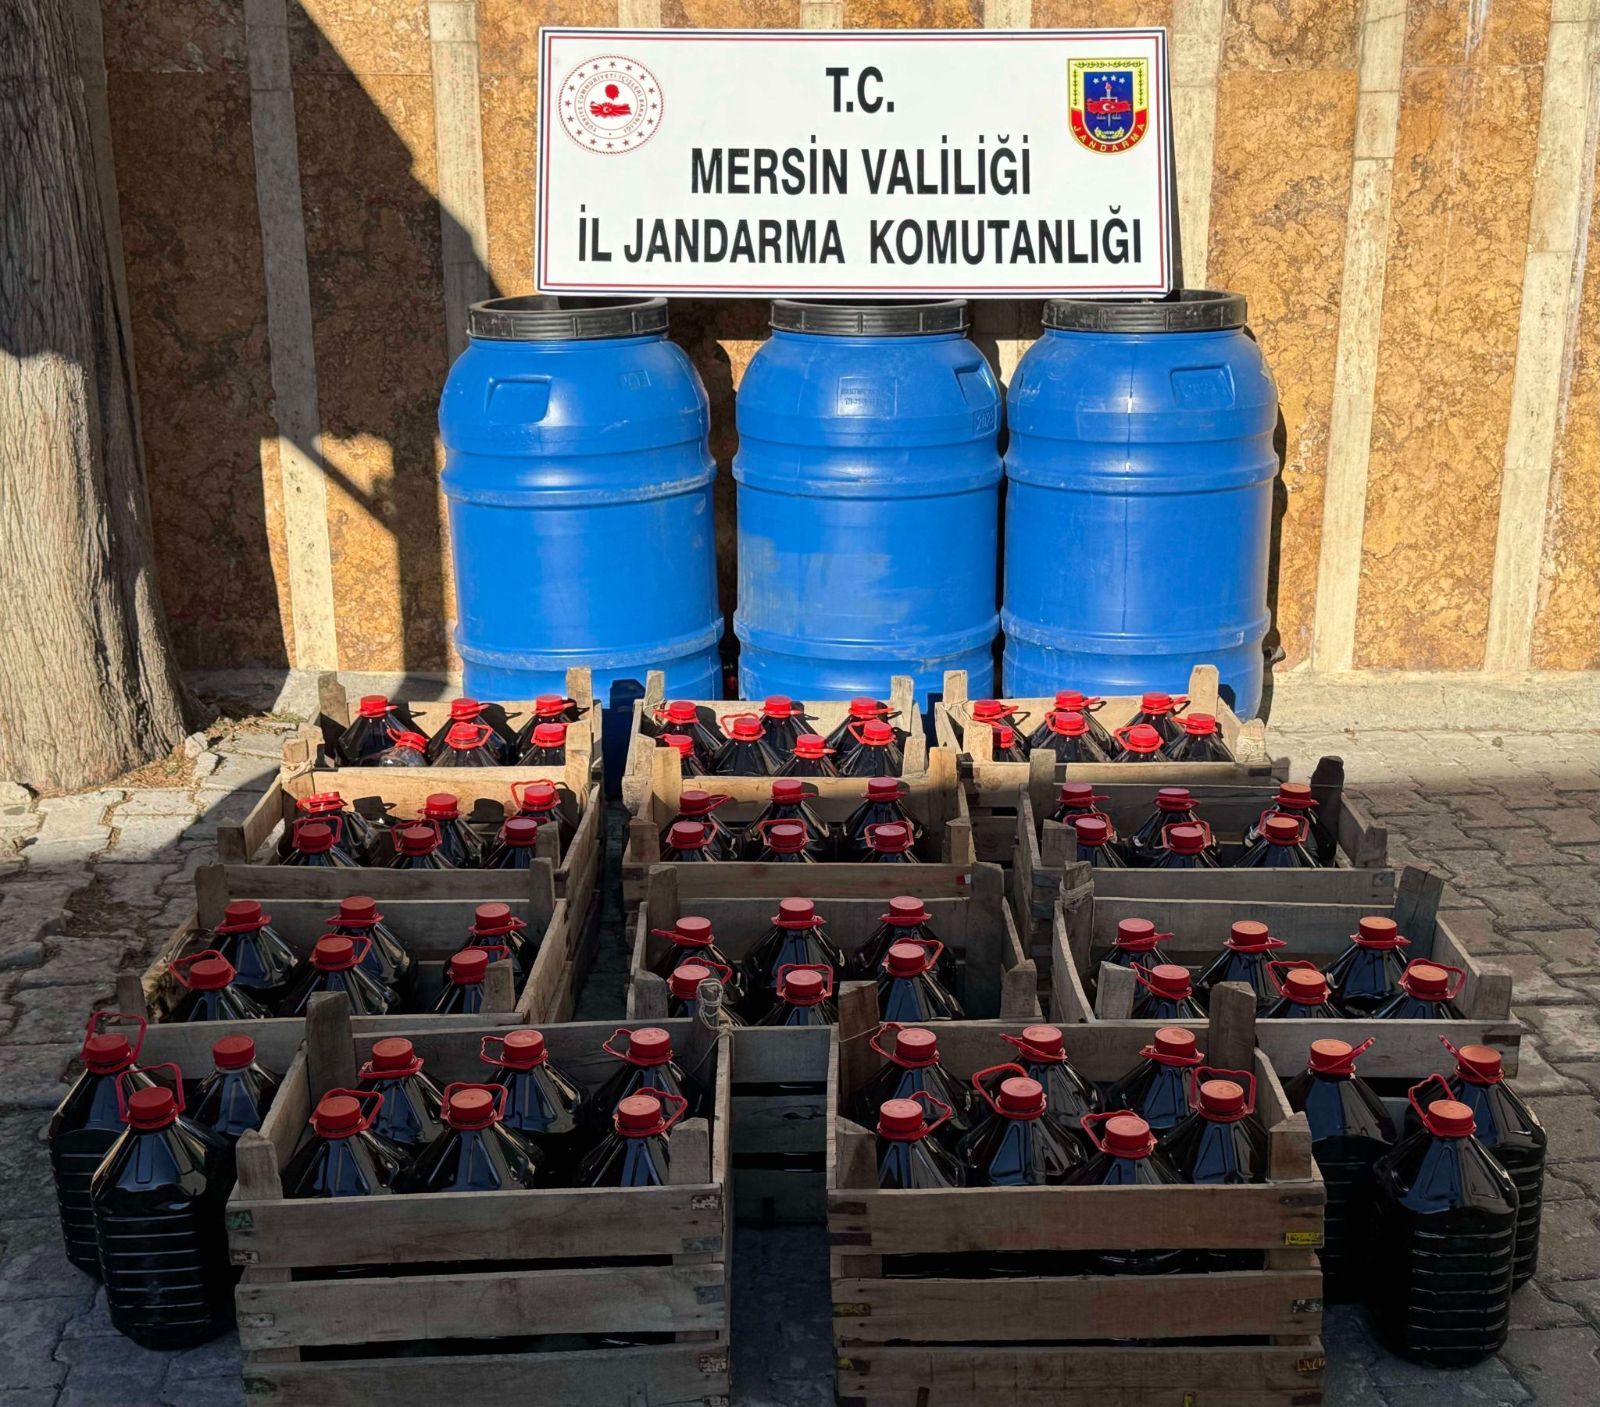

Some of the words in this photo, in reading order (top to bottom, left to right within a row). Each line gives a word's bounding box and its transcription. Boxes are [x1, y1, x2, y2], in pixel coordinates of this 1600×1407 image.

[826, 67, 894, 113] T.C.
[692, 135, 847, 195] MERSİN
[862, 133, 1029, 195] VALİLİĞİ
[1073, 124, 1145, 152] JANDARMA
[579, 205, 611, 261] İL
[625, 219, 845, 263] JANDARMA
[871, 206, 1140, 264] KOMUTANLIĞI
